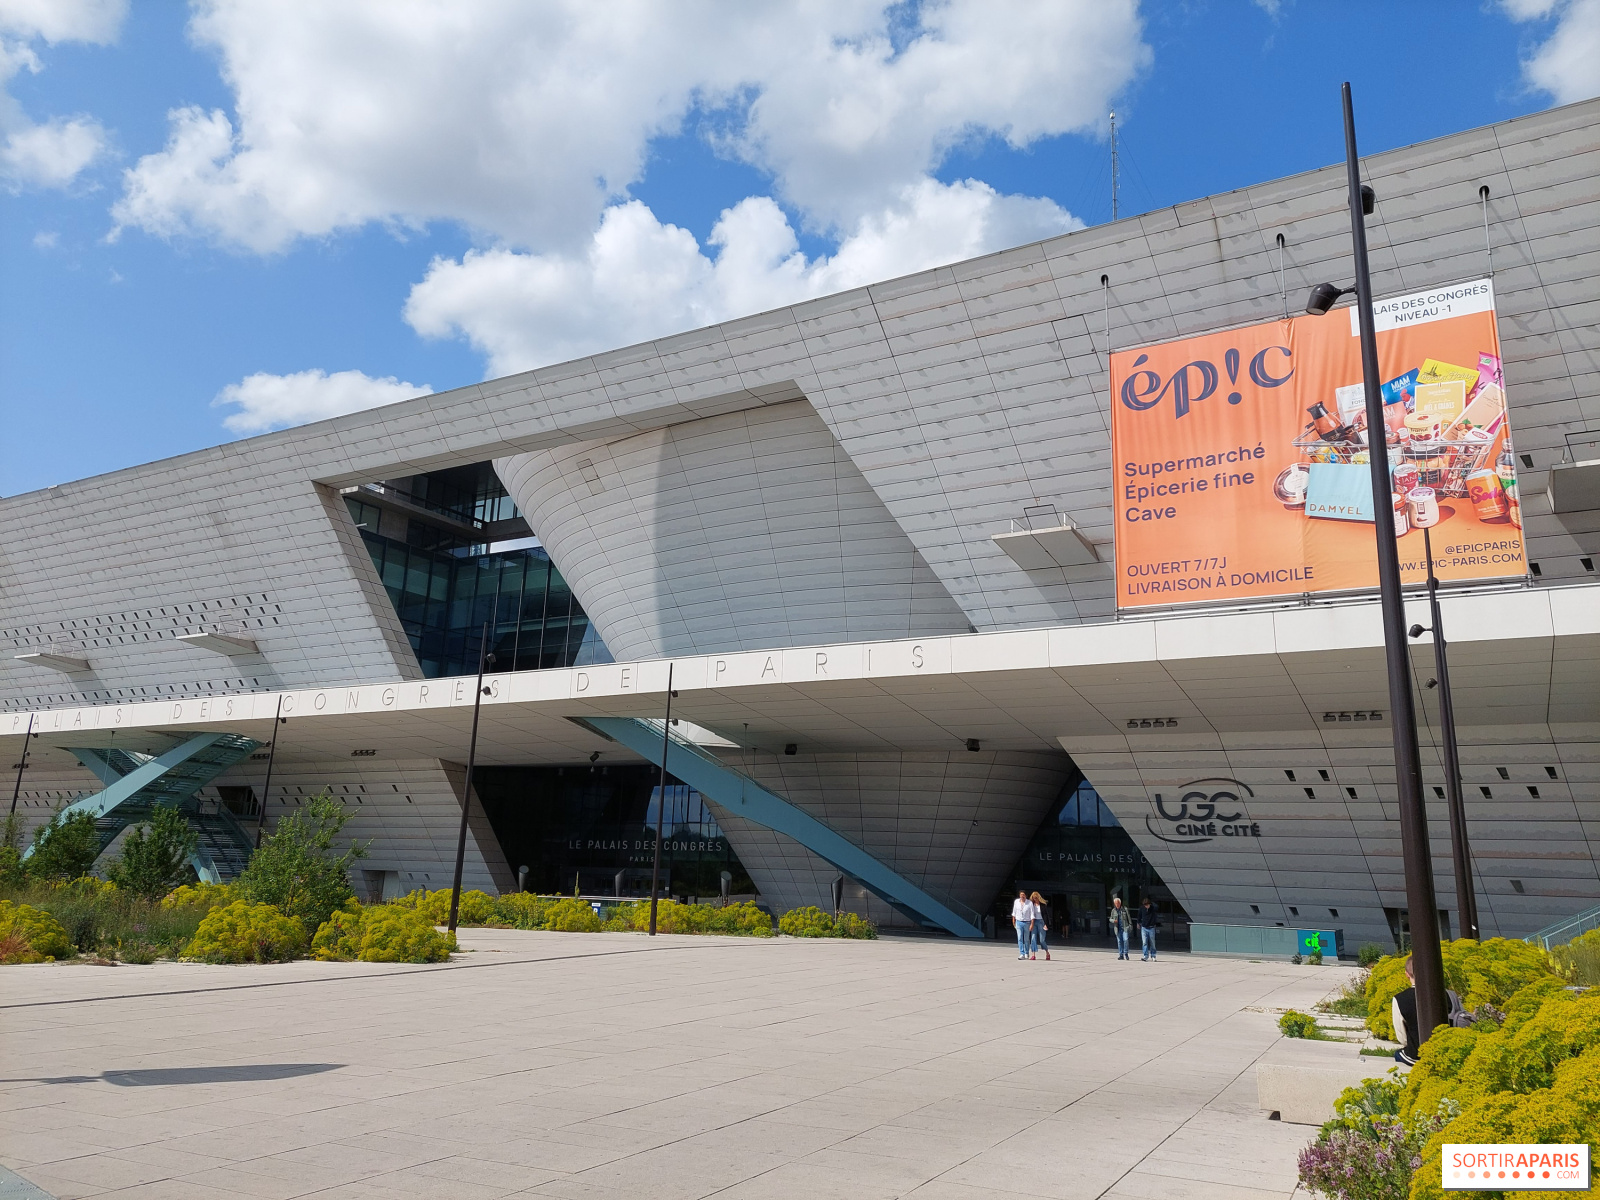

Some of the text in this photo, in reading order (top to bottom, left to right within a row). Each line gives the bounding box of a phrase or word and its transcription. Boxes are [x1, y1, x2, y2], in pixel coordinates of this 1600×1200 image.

[1373, 284, 1489, 315] LAIS DES CONGRÈS
[1395, 304, 1452, 323] NIVEAU -1
[1125, 442, 1265, 478] Supermarché
[1125, 472, 1255, 502] Épicerie fine
[1125, 506, 1177, 522] Cave
[1309, 503, 1363, 515] DAMYEL
[1445, 540, 1520, 554] @EPICPARIS
[1127, 556, 1227, 577] OUVERT 7/7J
[1128, 566, 1314, 595] LIVRAISON À DOMICILE
[13, 645, 924, 730] PALAIS DES CONGRÈS DE PARIS
[1155, 791, 1242, 822] UGC
[1175, 822, 1261, 837] CINÉ CITÉ
[569, 839, 722, 851] LE PALAIS DES CONGRÈS
[1039, 853, 1052, 861] LE
[1060, 853, 1102, 862] PALAIS
[1110, 854, 1133, 863] DES
